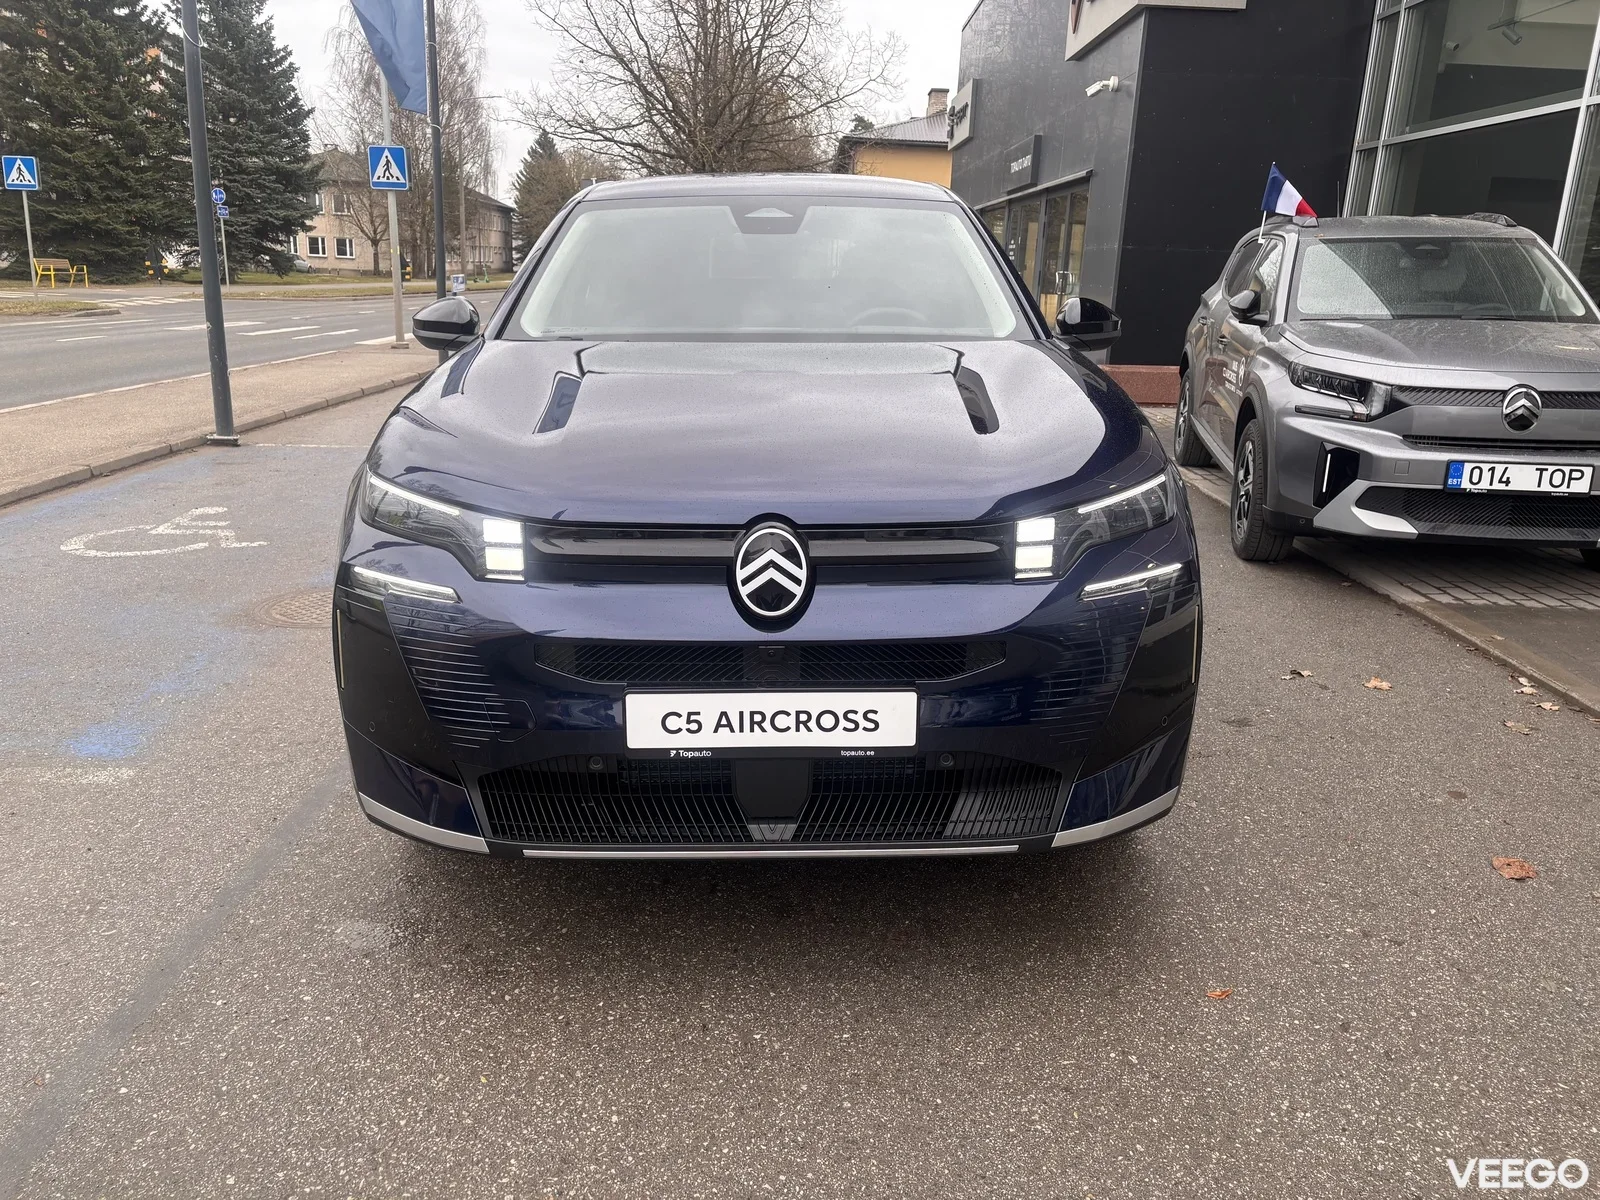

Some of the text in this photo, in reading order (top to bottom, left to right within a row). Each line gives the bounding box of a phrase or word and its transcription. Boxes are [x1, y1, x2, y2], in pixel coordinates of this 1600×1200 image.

[1448, 478, 1462, 486] EST
[1468, 465, 1585, 489] 014 TOP
[660, 709, 880, 735] C5 AIRCROSS
[678, 750, 712, 758] Topauto
